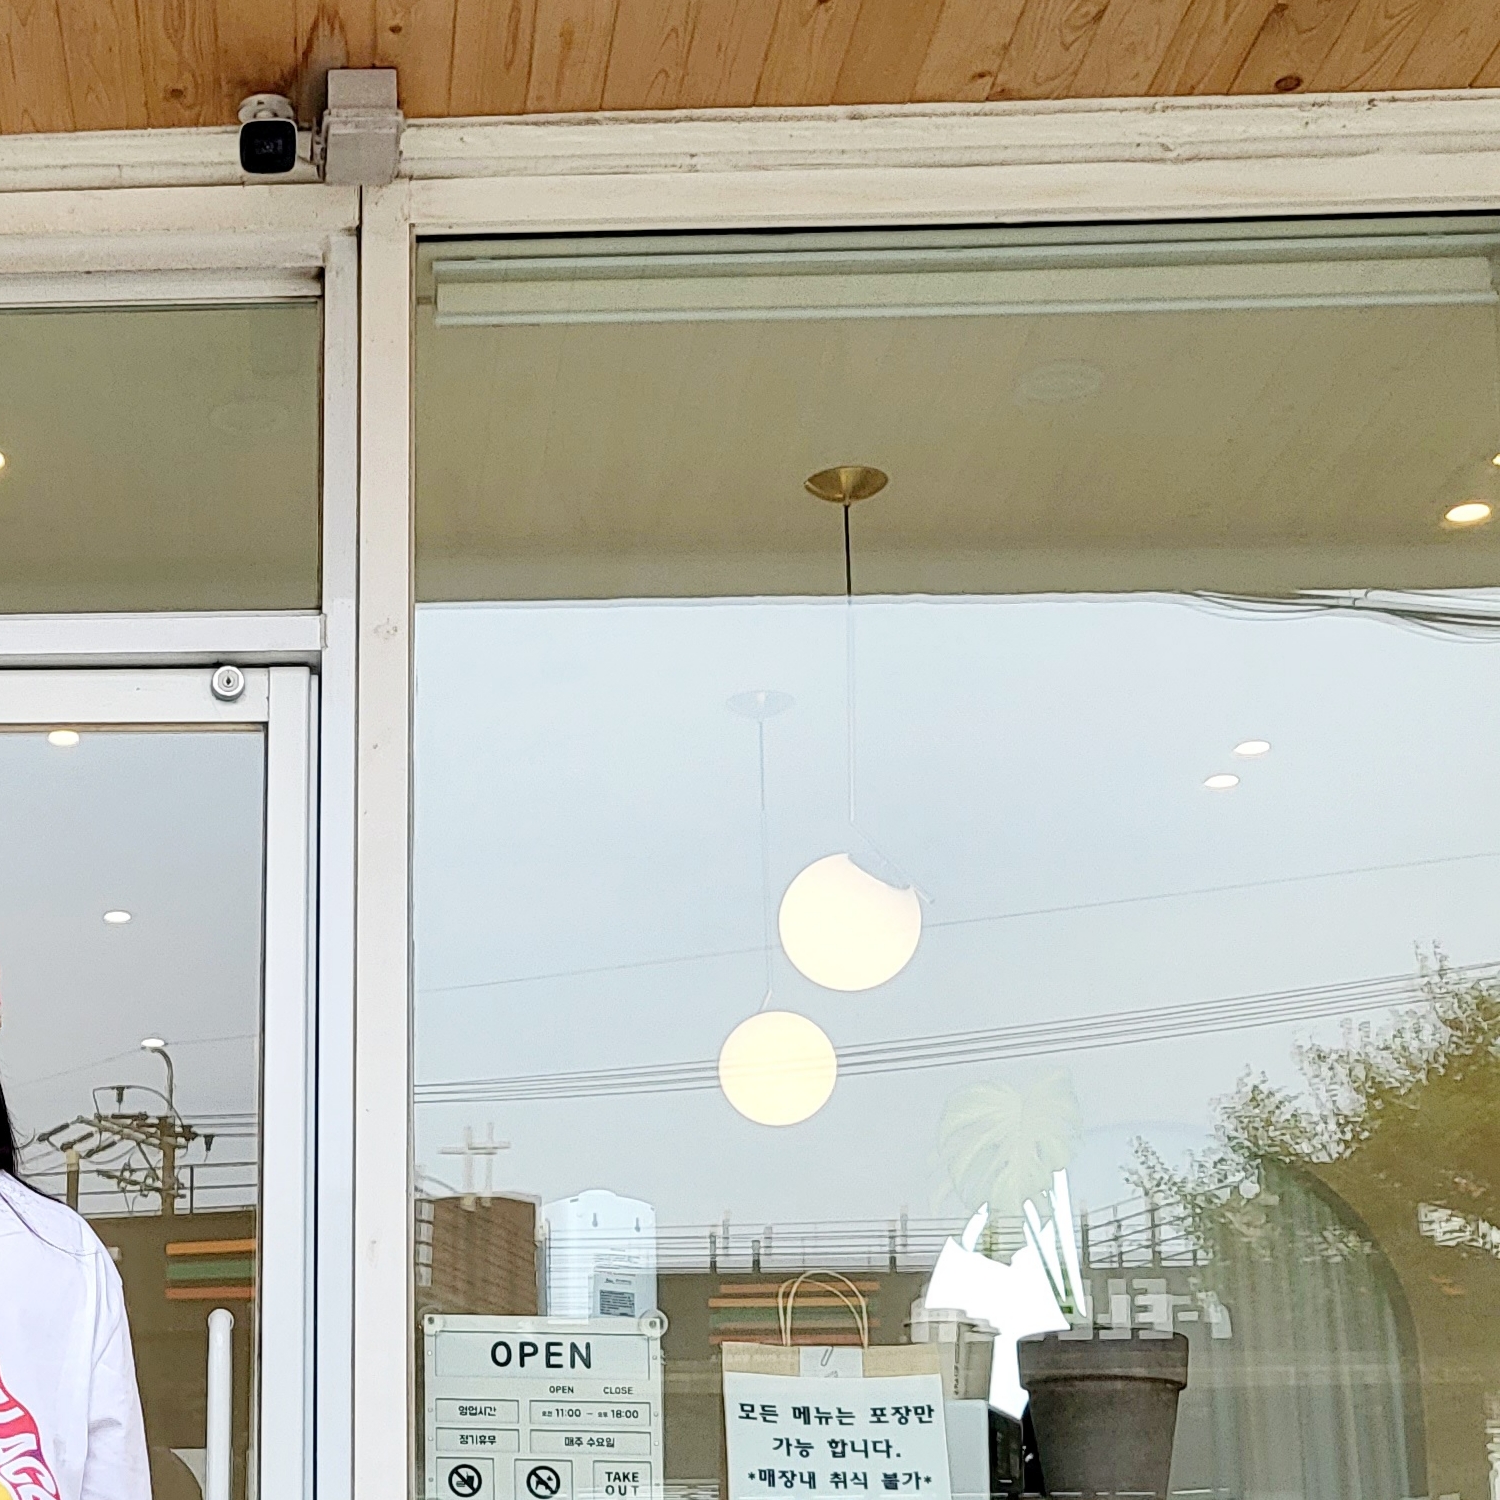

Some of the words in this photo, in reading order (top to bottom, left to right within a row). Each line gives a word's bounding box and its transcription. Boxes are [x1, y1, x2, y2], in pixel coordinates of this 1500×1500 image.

[490, 1340, 592, 1370] OPEN
[549, 1385, 575, 1394] OPEN
[603, 1386, 634, 1395] CLOSE
[458, 1405, 497, 1417] 영업시간
[555, 1408, 581, 1418] 11:00
[610, 1409, 639, 1419] 18:00
[738, 1402, 779, 1423] 모든
[792, 1405, 856, 1426] 메뉴는
[869, 1404, 935, 1425] 포장만
[459, 1434, 497, 1445] 정기휴무
[564, 1436, 583, 1447] 매주
[586, 1437, 615, 1448] 수요일
[772, 1437, 815, 1458] 가능
[827, 1438, 901, 1459] 합니다.
[605, 1472, 639, 1483] TAKE
[829, 1472, 869, 1489] 취식
[605, 1485, 639, 1496] OUT
